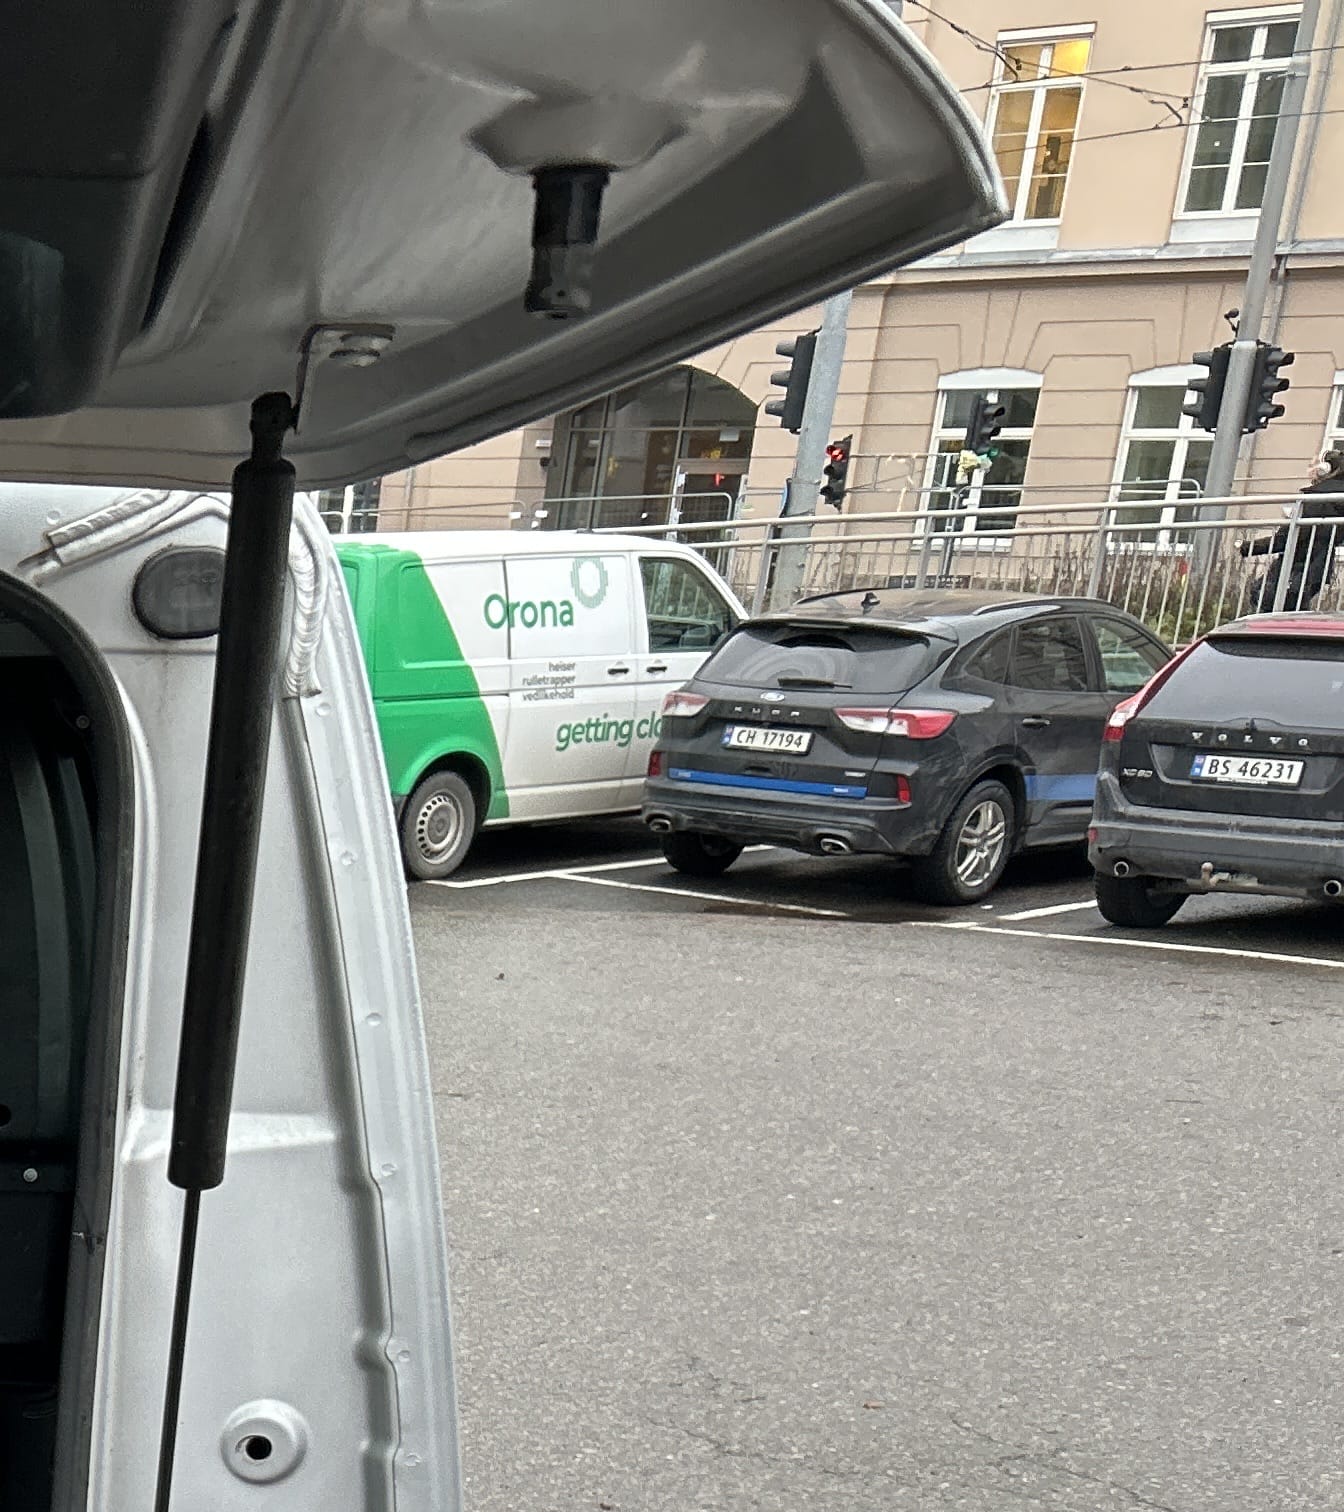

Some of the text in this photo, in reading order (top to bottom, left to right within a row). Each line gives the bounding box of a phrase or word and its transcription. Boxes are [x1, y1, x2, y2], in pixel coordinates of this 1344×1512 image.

[483, 593, 574, 629] Orona
[556, 712, 634, 751] getting
[737, 730, 803, 748] CH 17194
[1192, 732, 1308, 746] VOLVO
[1208, 759, 1294, 779] BS 46231
